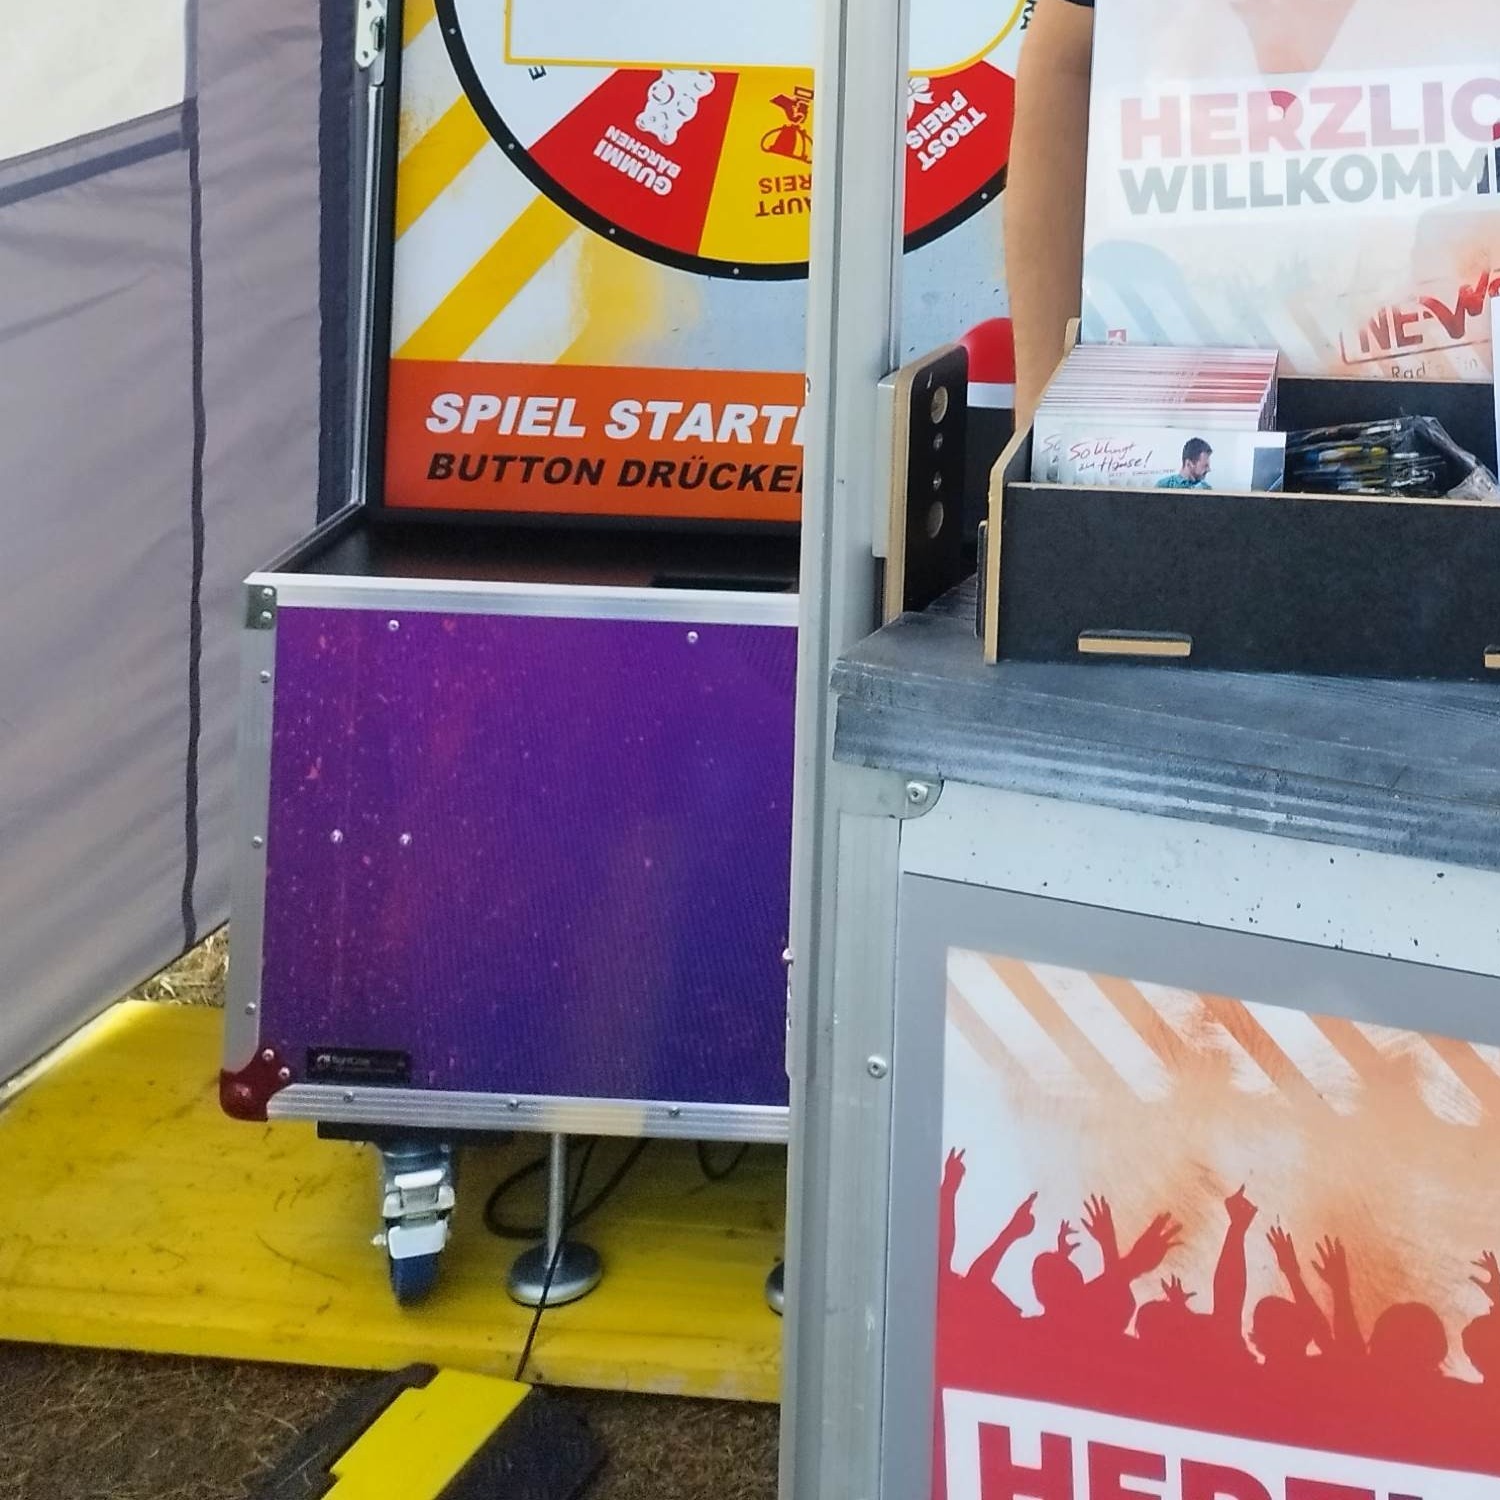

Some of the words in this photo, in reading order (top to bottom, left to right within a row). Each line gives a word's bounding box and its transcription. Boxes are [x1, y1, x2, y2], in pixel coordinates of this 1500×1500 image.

[906, 89, 969, 150] PREIS
[917, 106, 988, 172] TROST
[593, 138, 673, 197] GUMMI
[604, 124, 682, 179] BÄRCHEN
[755, 197, 812, 218] AUPT
[759, 175, 812, 194] REIS
[424, 392, 586, 441] SPIEL
[425, 452, 604, 487] BUTTON
[617, 454, 804, 493] DRÜCKE
